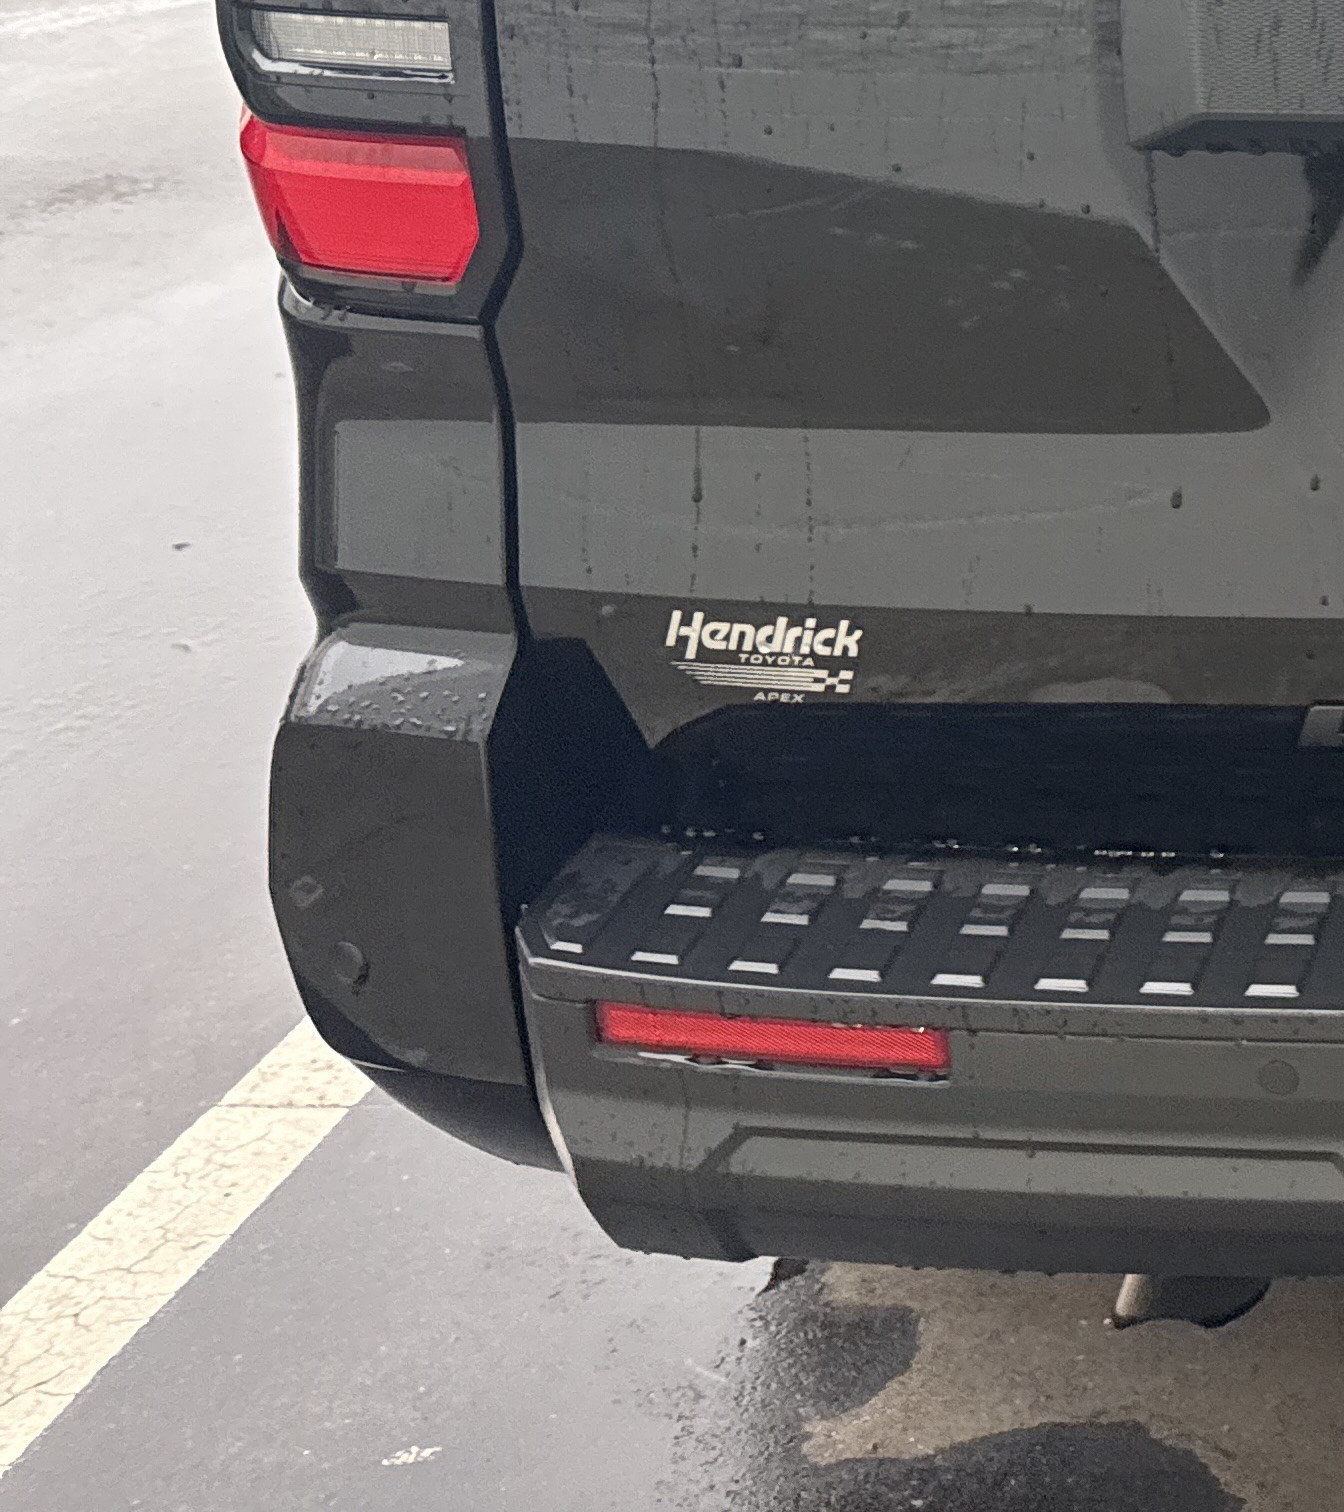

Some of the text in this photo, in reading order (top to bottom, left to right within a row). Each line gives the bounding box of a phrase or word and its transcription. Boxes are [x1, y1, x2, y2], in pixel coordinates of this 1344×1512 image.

[665, 609, 863, 660] Hendrick
[738, 653, 816, 667] TOYOTA
[753, 691, 806, 704] APEX
